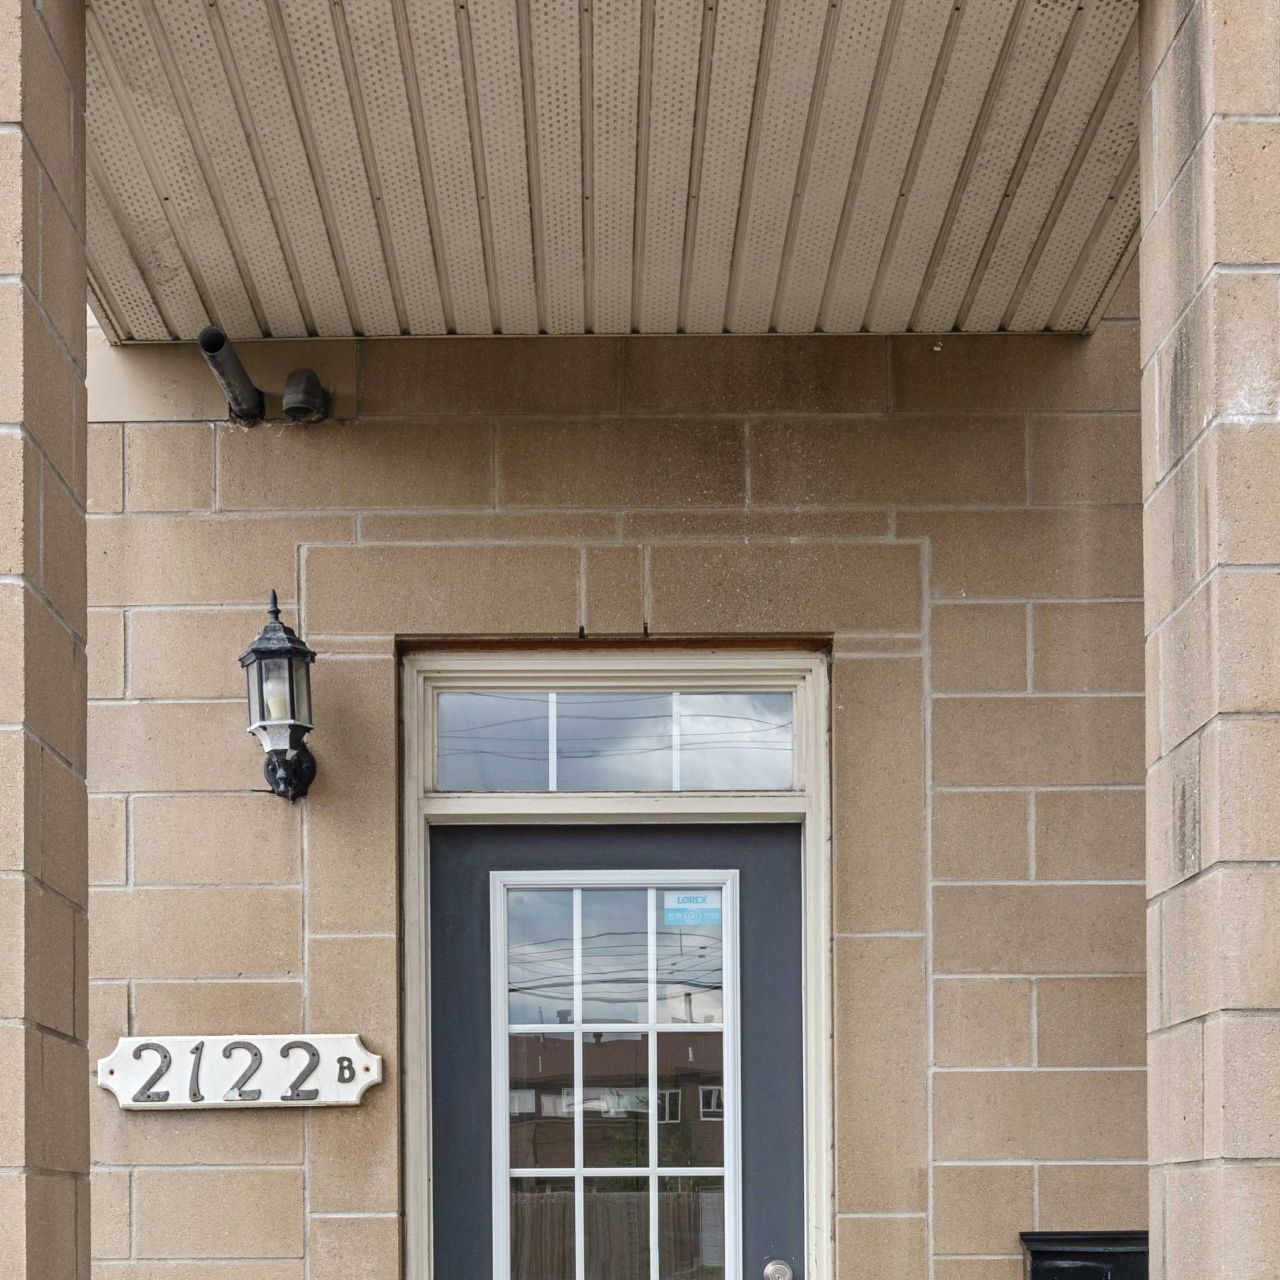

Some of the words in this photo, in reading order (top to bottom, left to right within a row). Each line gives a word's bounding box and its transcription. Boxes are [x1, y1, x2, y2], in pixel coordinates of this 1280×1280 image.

[677, 895, 708, 904] LOREX
[131, 1040, 320, 1103] 2122
[336, 1056, 357, 1084] B
